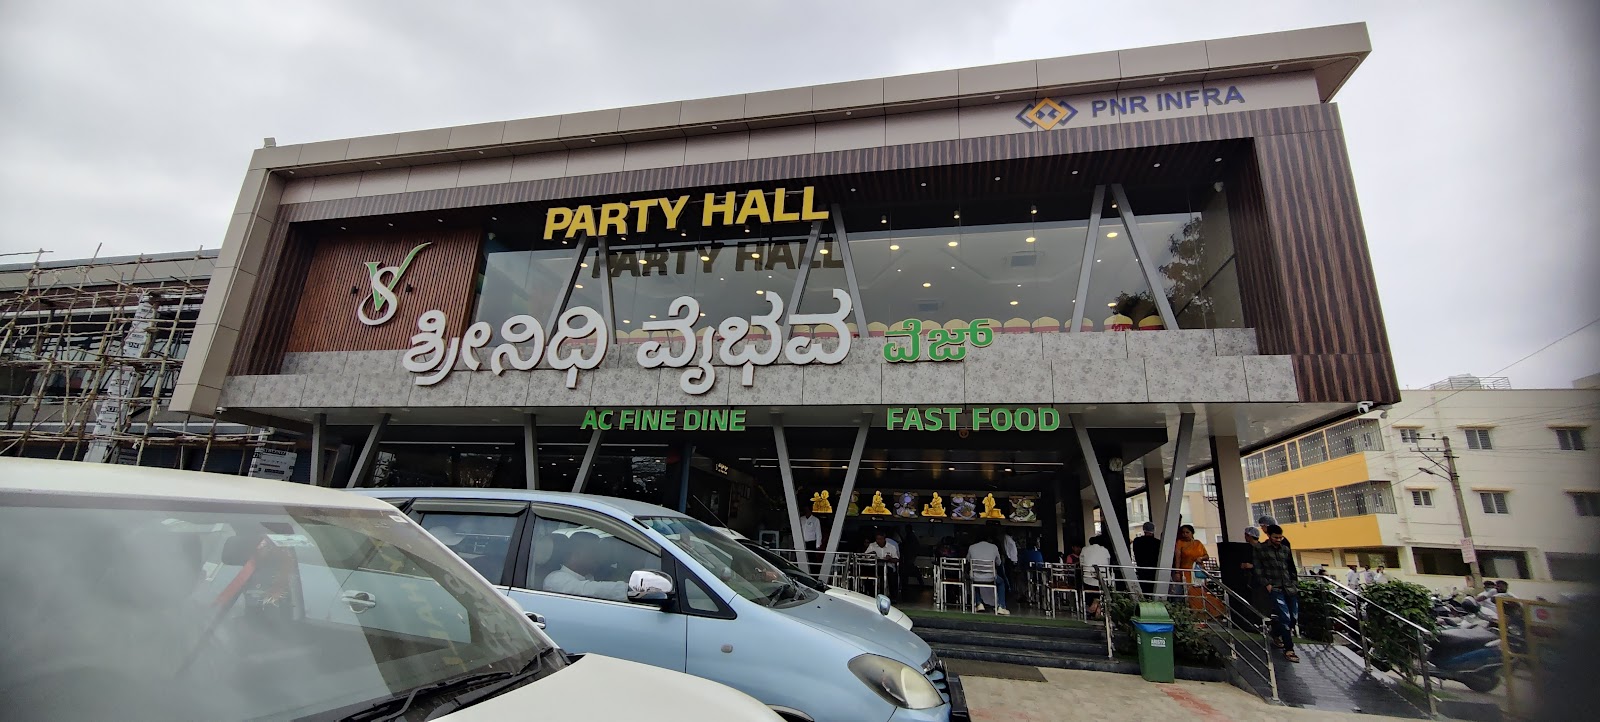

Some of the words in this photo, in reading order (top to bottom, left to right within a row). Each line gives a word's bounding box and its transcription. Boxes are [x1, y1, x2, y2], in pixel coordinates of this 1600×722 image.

[1091, 95, 1149, 118] PNR
[1156, 85, 1245, 112] INFRA
[543, 194, 690, 241] PARTY
[702, 185, 829, 227] HALL
[402, 305, 609, 388] ಶ್ರೀನಿಧಿ
[636, 288, 853, 395] ವೈಭವ
[883, 318, 994, 364] ವೆಜ್
[580, 409, 613, 431] AC
[619, 409, 676, 432] FINE
[683, 408, 747, 432] DINE
[886, 407, 962, 431] FAST
[972, 407, 1061, 431] FOOD
